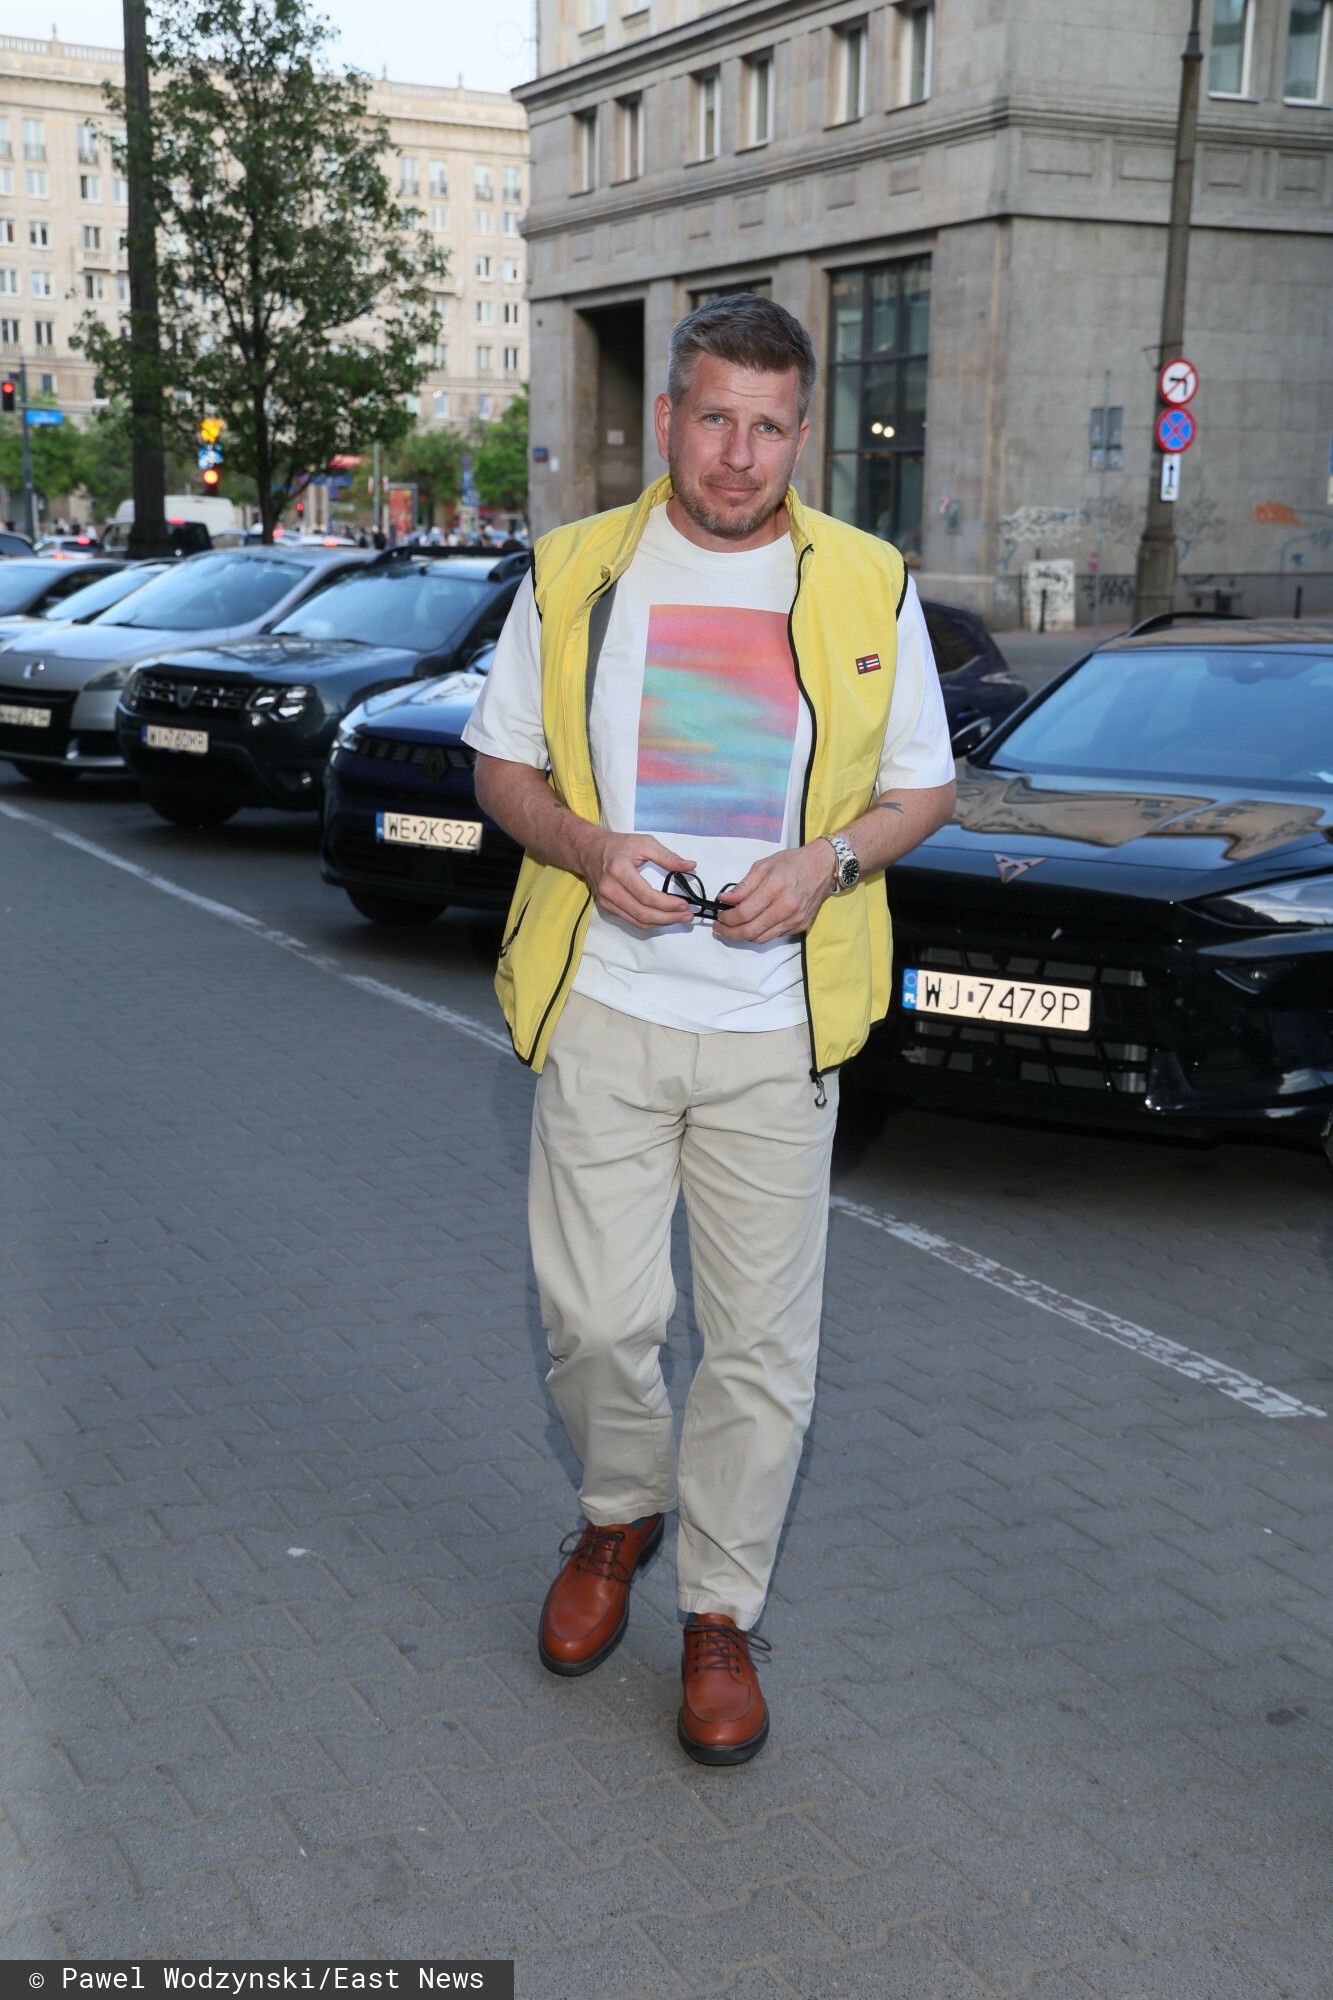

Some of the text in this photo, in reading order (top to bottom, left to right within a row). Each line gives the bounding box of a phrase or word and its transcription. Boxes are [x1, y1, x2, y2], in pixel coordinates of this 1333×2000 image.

[388, 815, 477, 847] WE 2KS22
[925, 975, 1081, 1024] WJ 7479P
